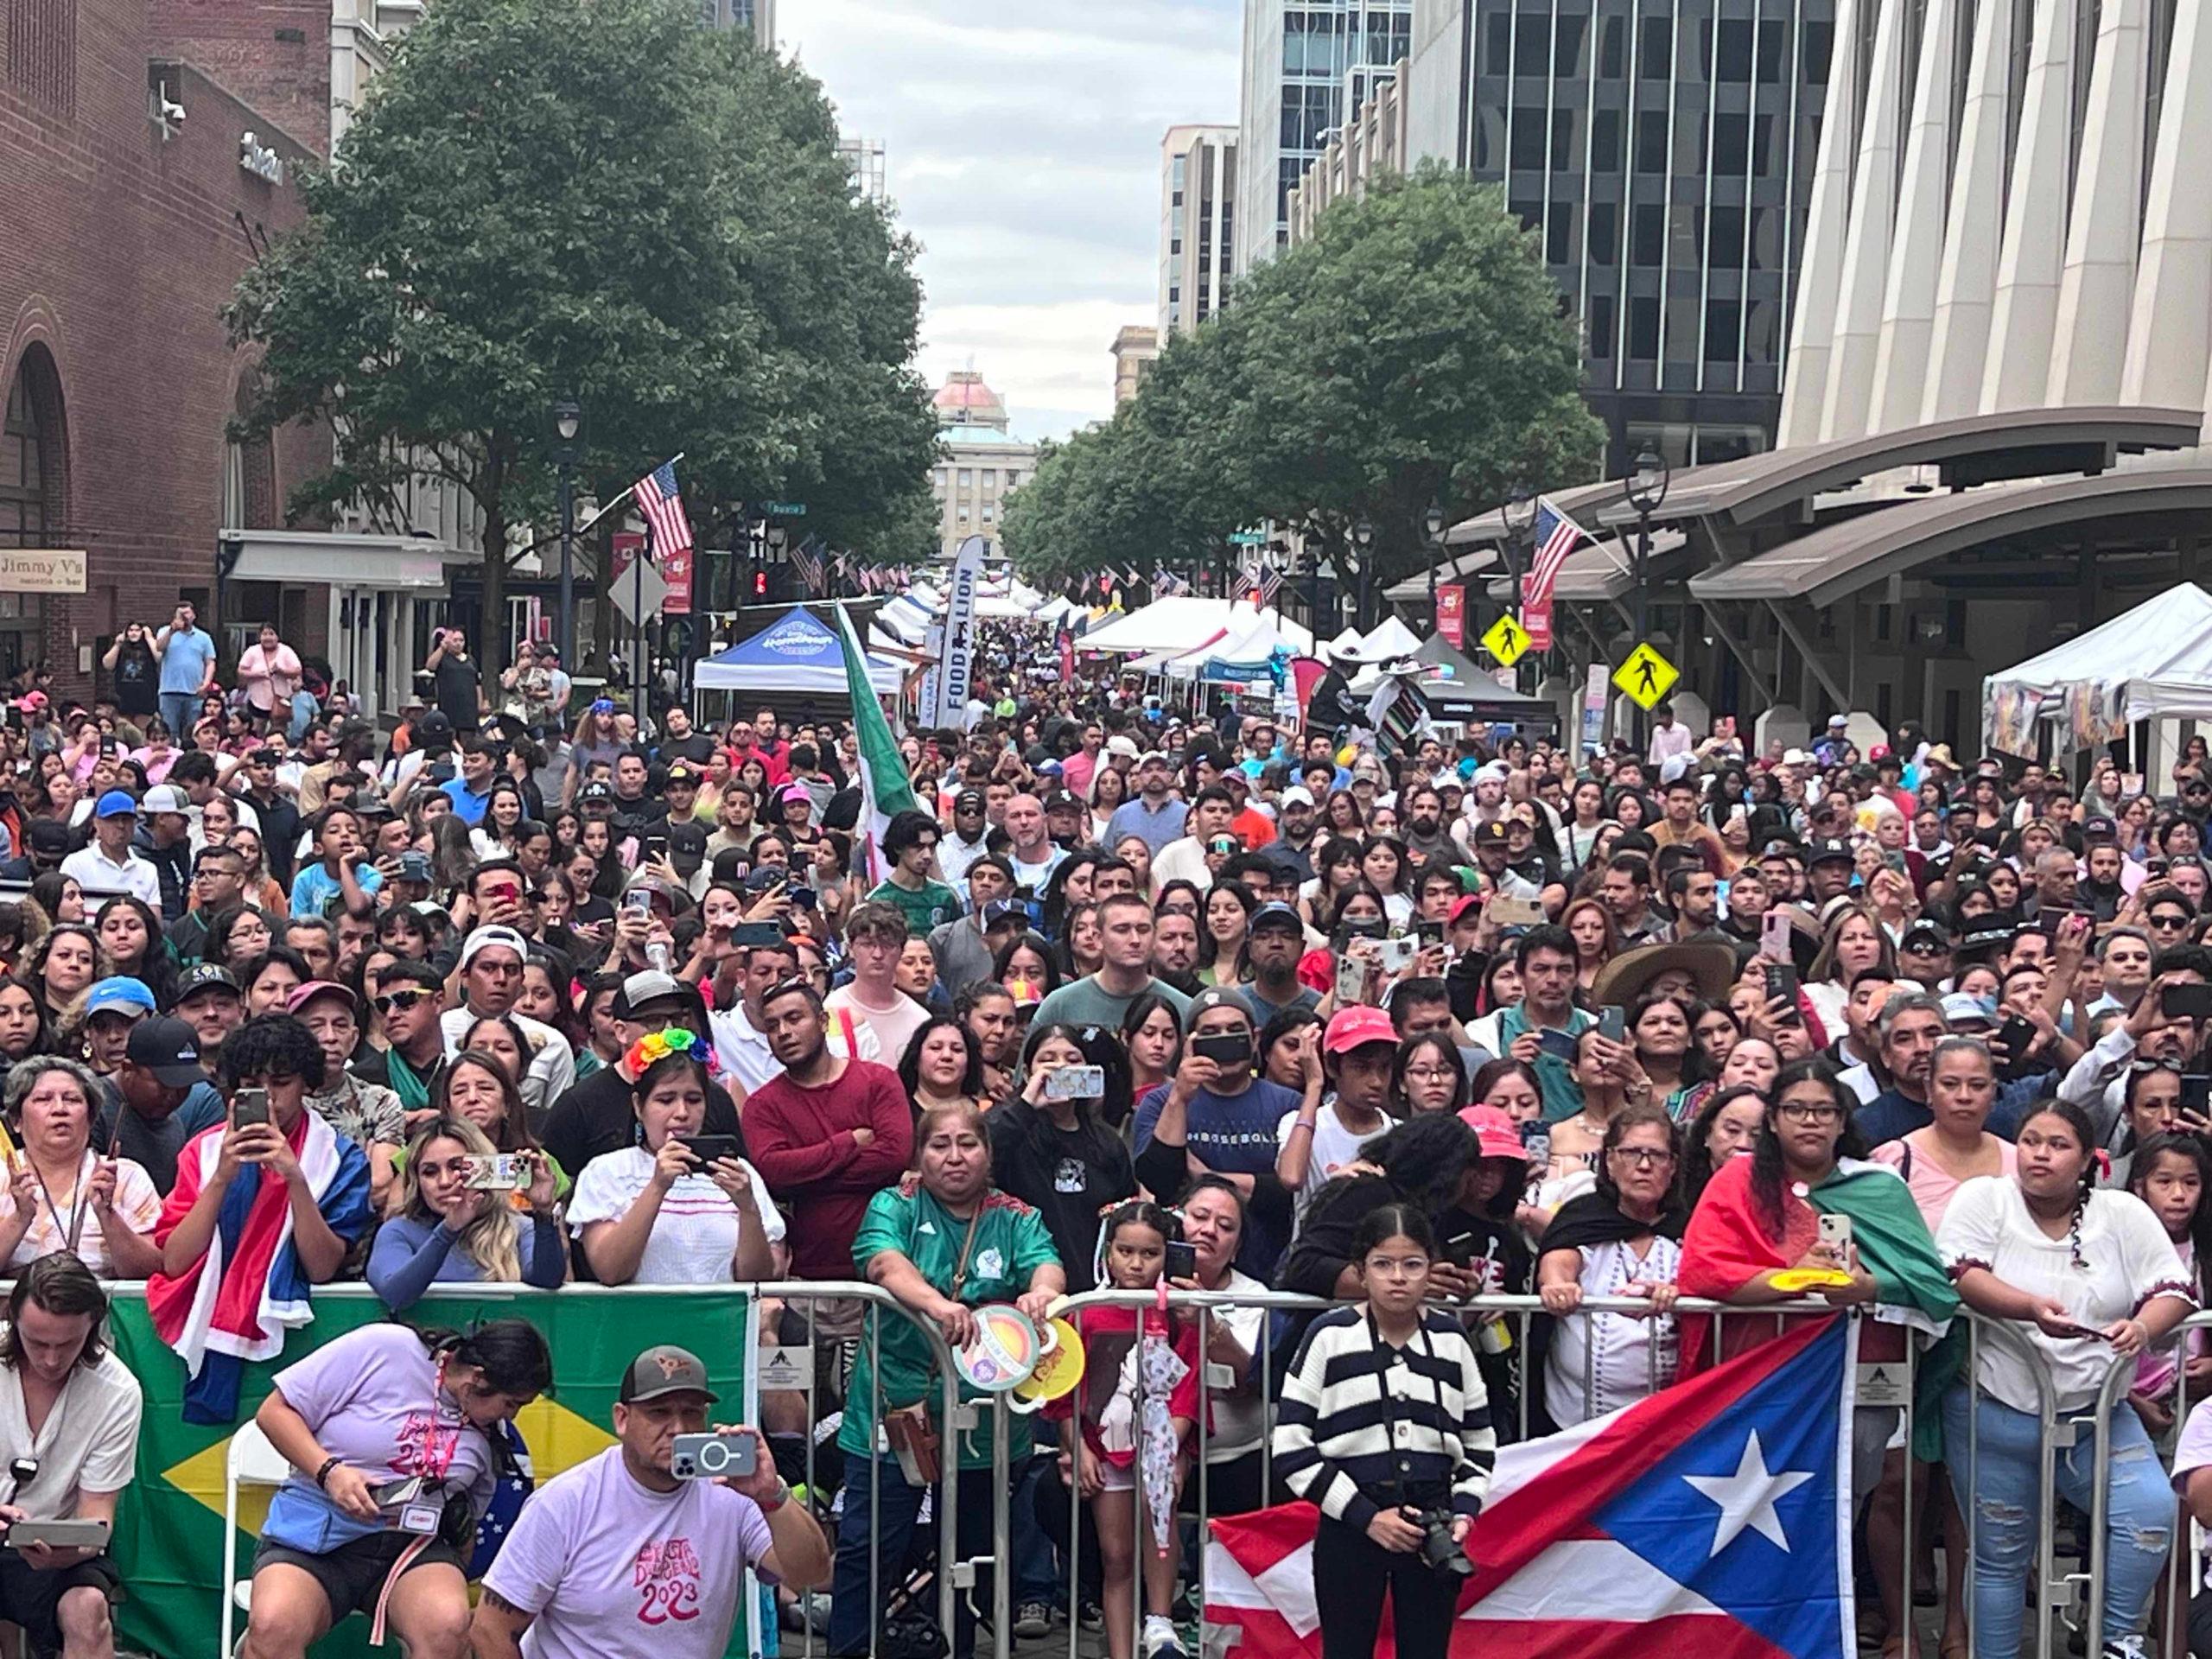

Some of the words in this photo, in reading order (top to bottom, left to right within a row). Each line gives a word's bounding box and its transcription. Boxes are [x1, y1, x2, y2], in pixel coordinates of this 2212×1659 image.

[1, 558, 57, 576] Jimmy
[956, 569, 972, 618] LION
[947, 653, 966, 709] FOOD
[637, 1582, 700, 1625] 2023
